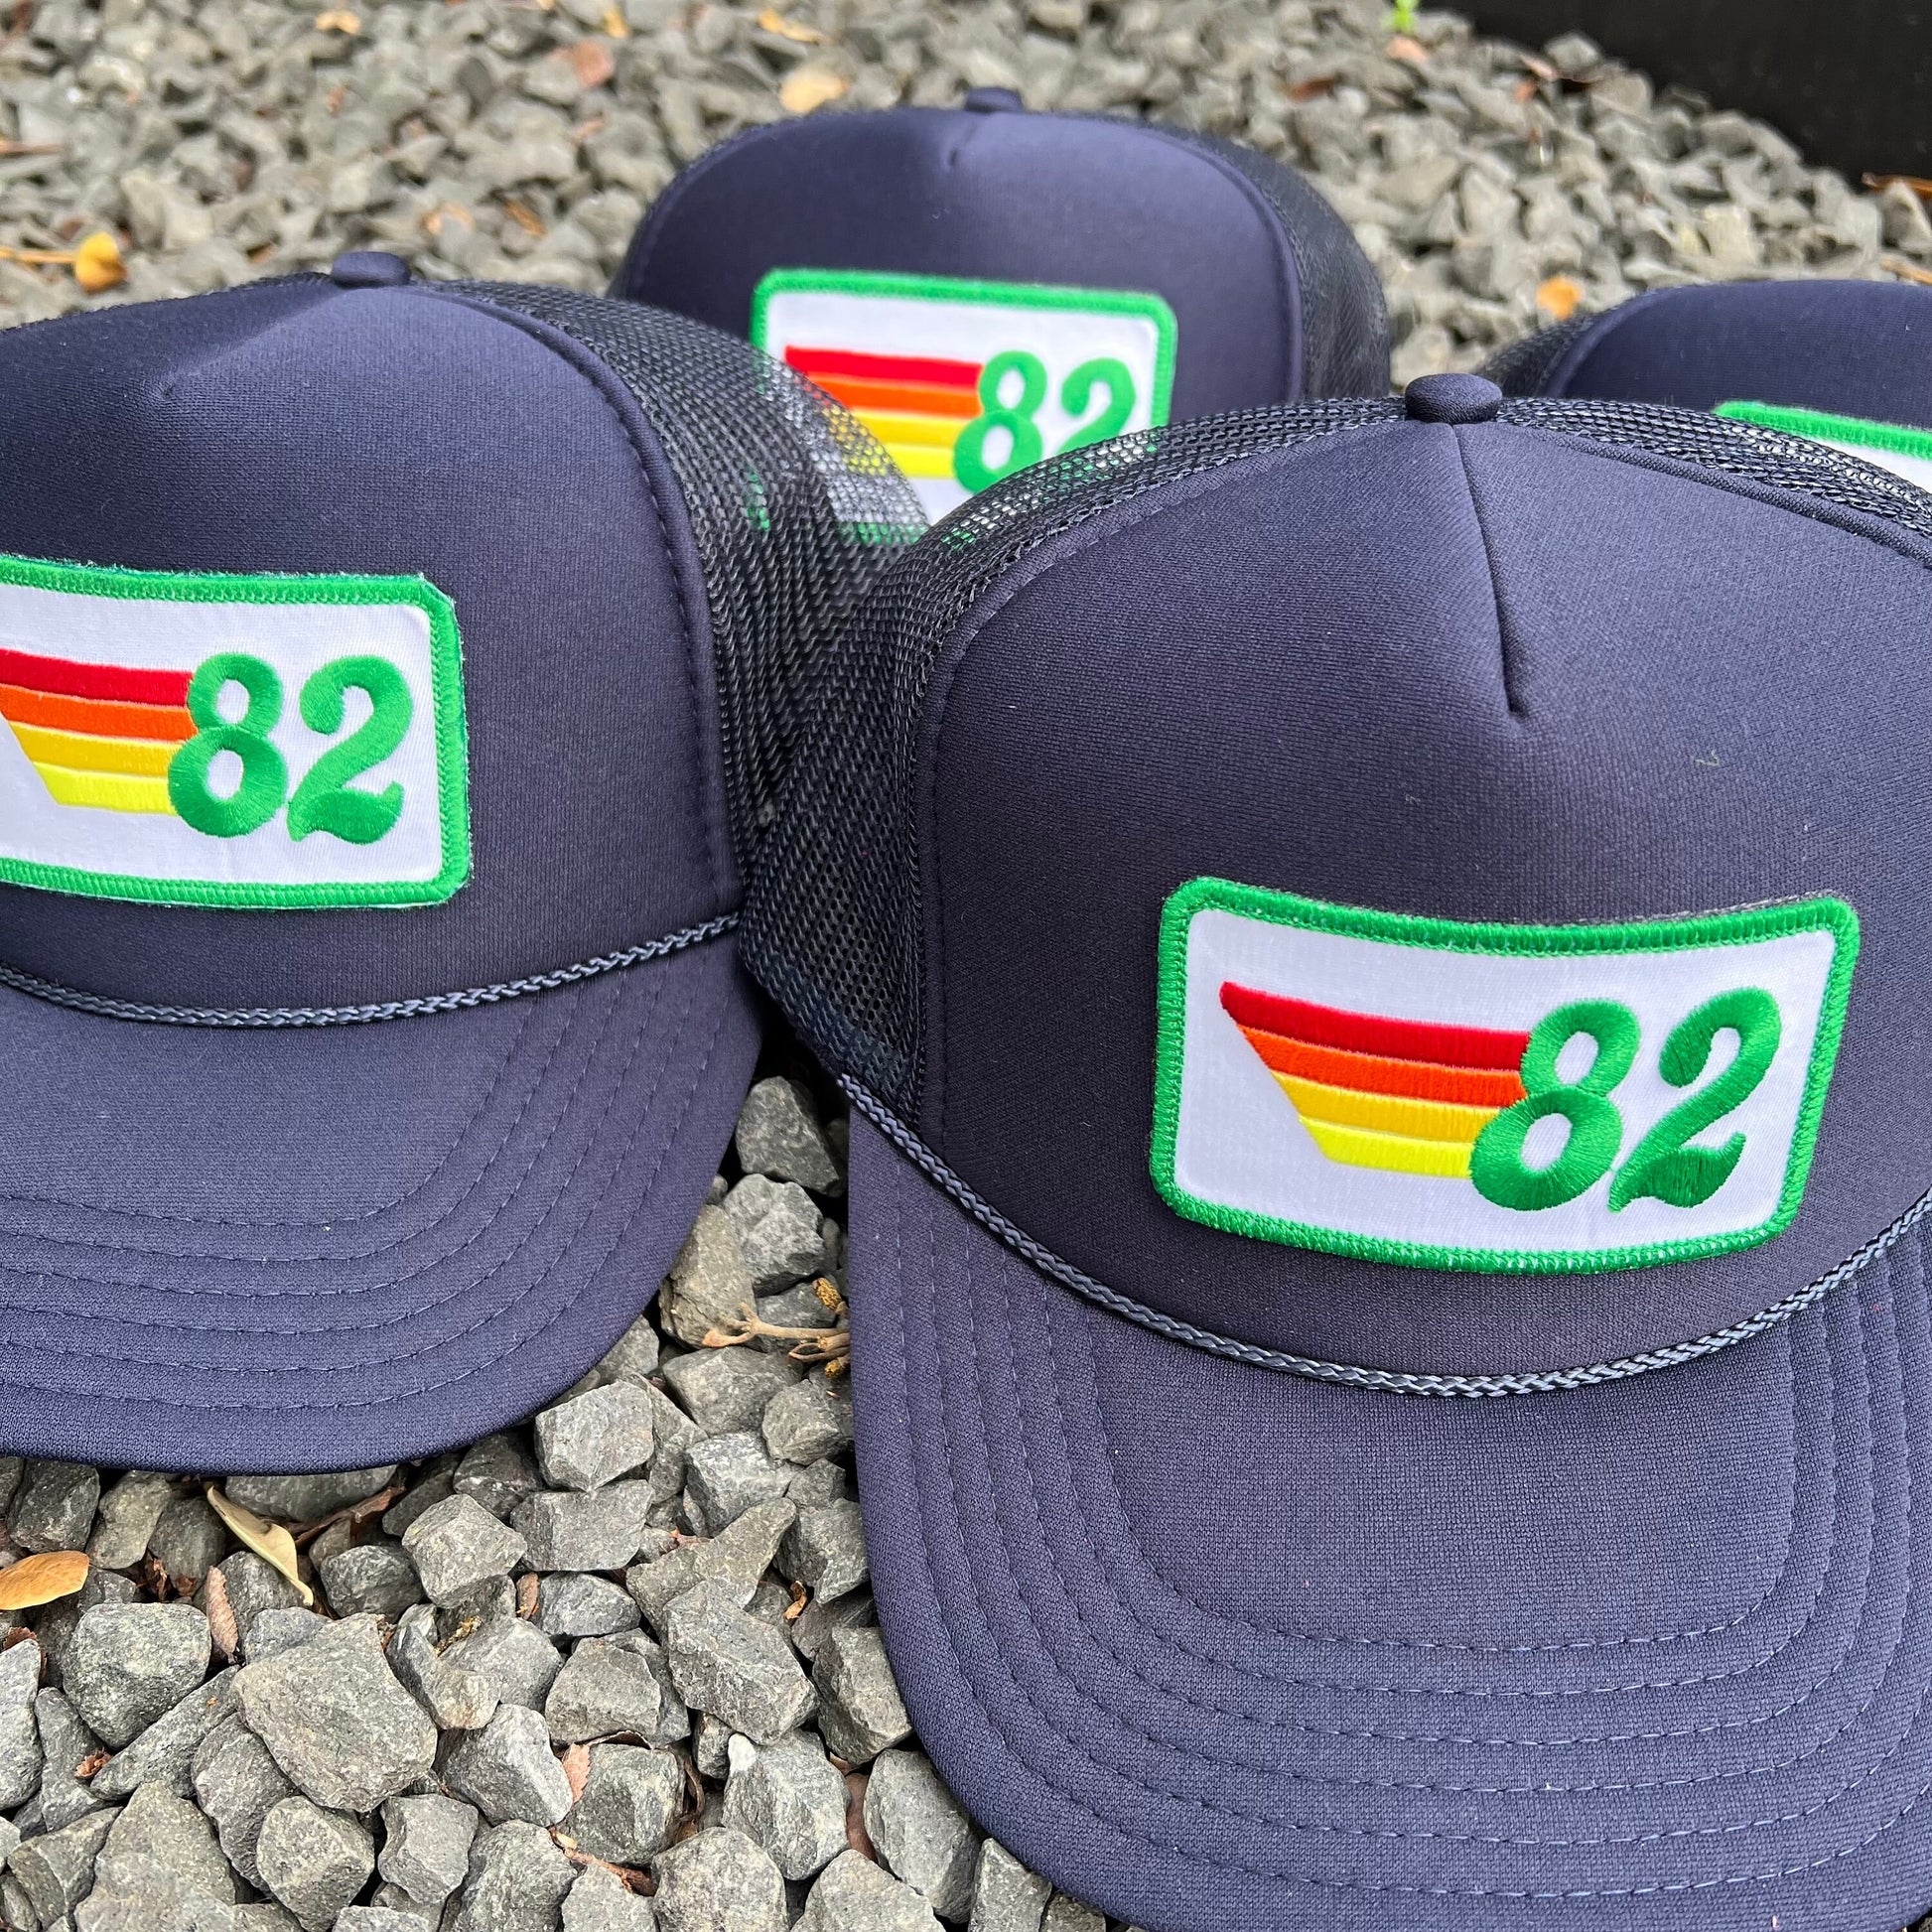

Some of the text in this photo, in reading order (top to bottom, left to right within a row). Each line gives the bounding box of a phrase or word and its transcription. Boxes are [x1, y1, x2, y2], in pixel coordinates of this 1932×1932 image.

[953, 350, 1136, 495] 82
[168, 653, 414, 846] 82
[1468, 987, 1783, 1213] 82
